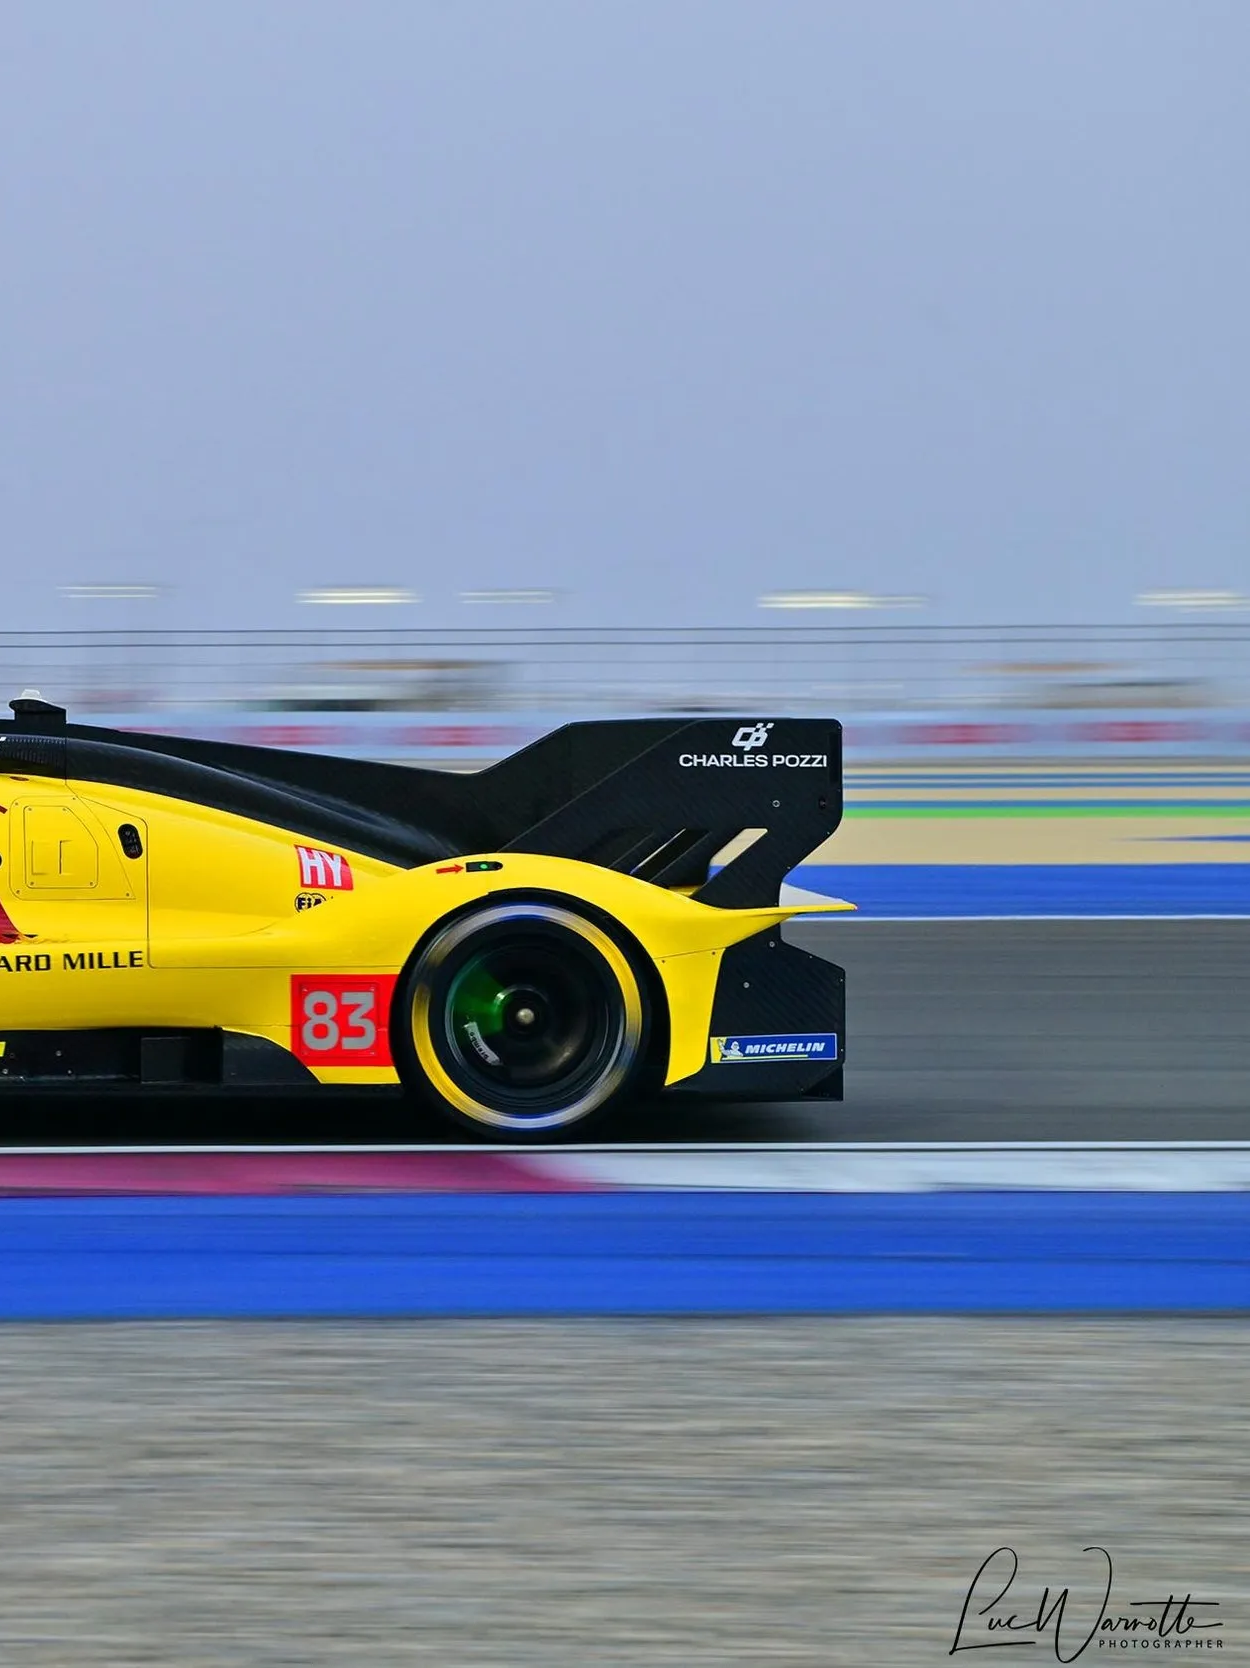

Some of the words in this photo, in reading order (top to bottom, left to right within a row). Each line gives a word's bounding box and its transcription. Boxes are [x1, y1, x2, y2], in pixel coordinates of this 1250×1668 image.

[679, 754, 768, 768] CHARLES
[772, 754, 828, 768] POZZI
[297, 847, 342, 887] HY
[63, 950, 143, 970] MILLE
[302, 990, 376, 1051] 83
[745, 1042, 826, 1054] MICHELIN
